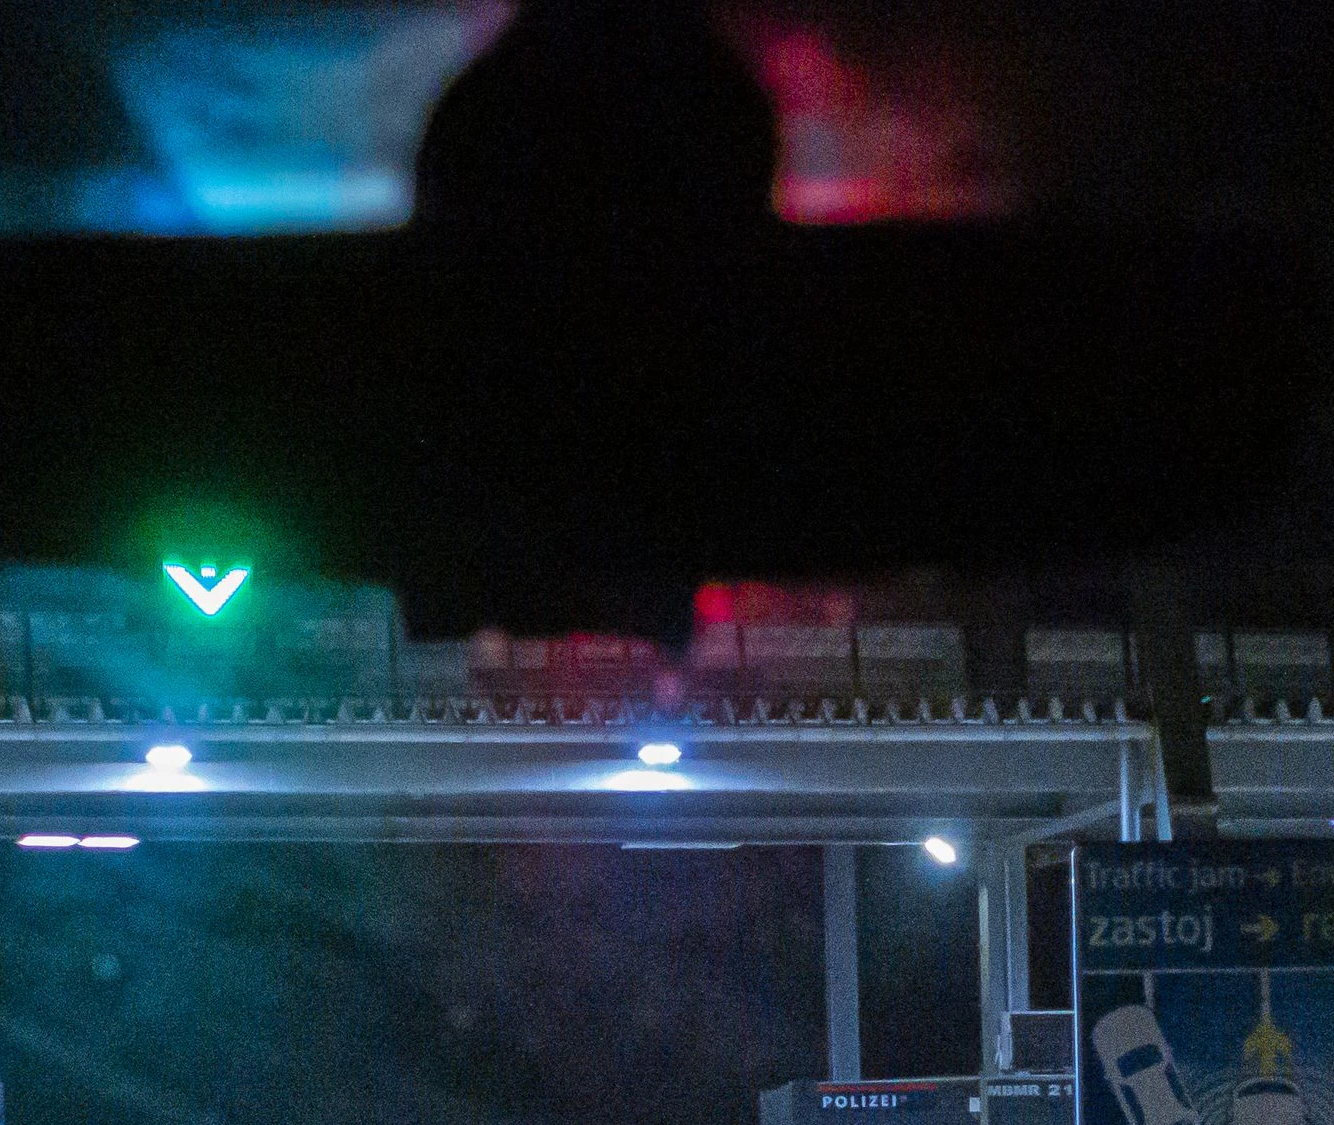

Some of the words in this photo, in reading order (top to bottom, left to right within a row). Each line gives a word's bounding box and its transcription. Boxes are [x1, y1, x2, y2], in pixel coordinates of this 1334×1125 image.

[1084, 860, 1181, 889] Traffic
[1189, 860, 1246, 895] jam
[1088, 904, 1215, 953] zastoj
[821, 1093, 898, 1110] POLIZEI
